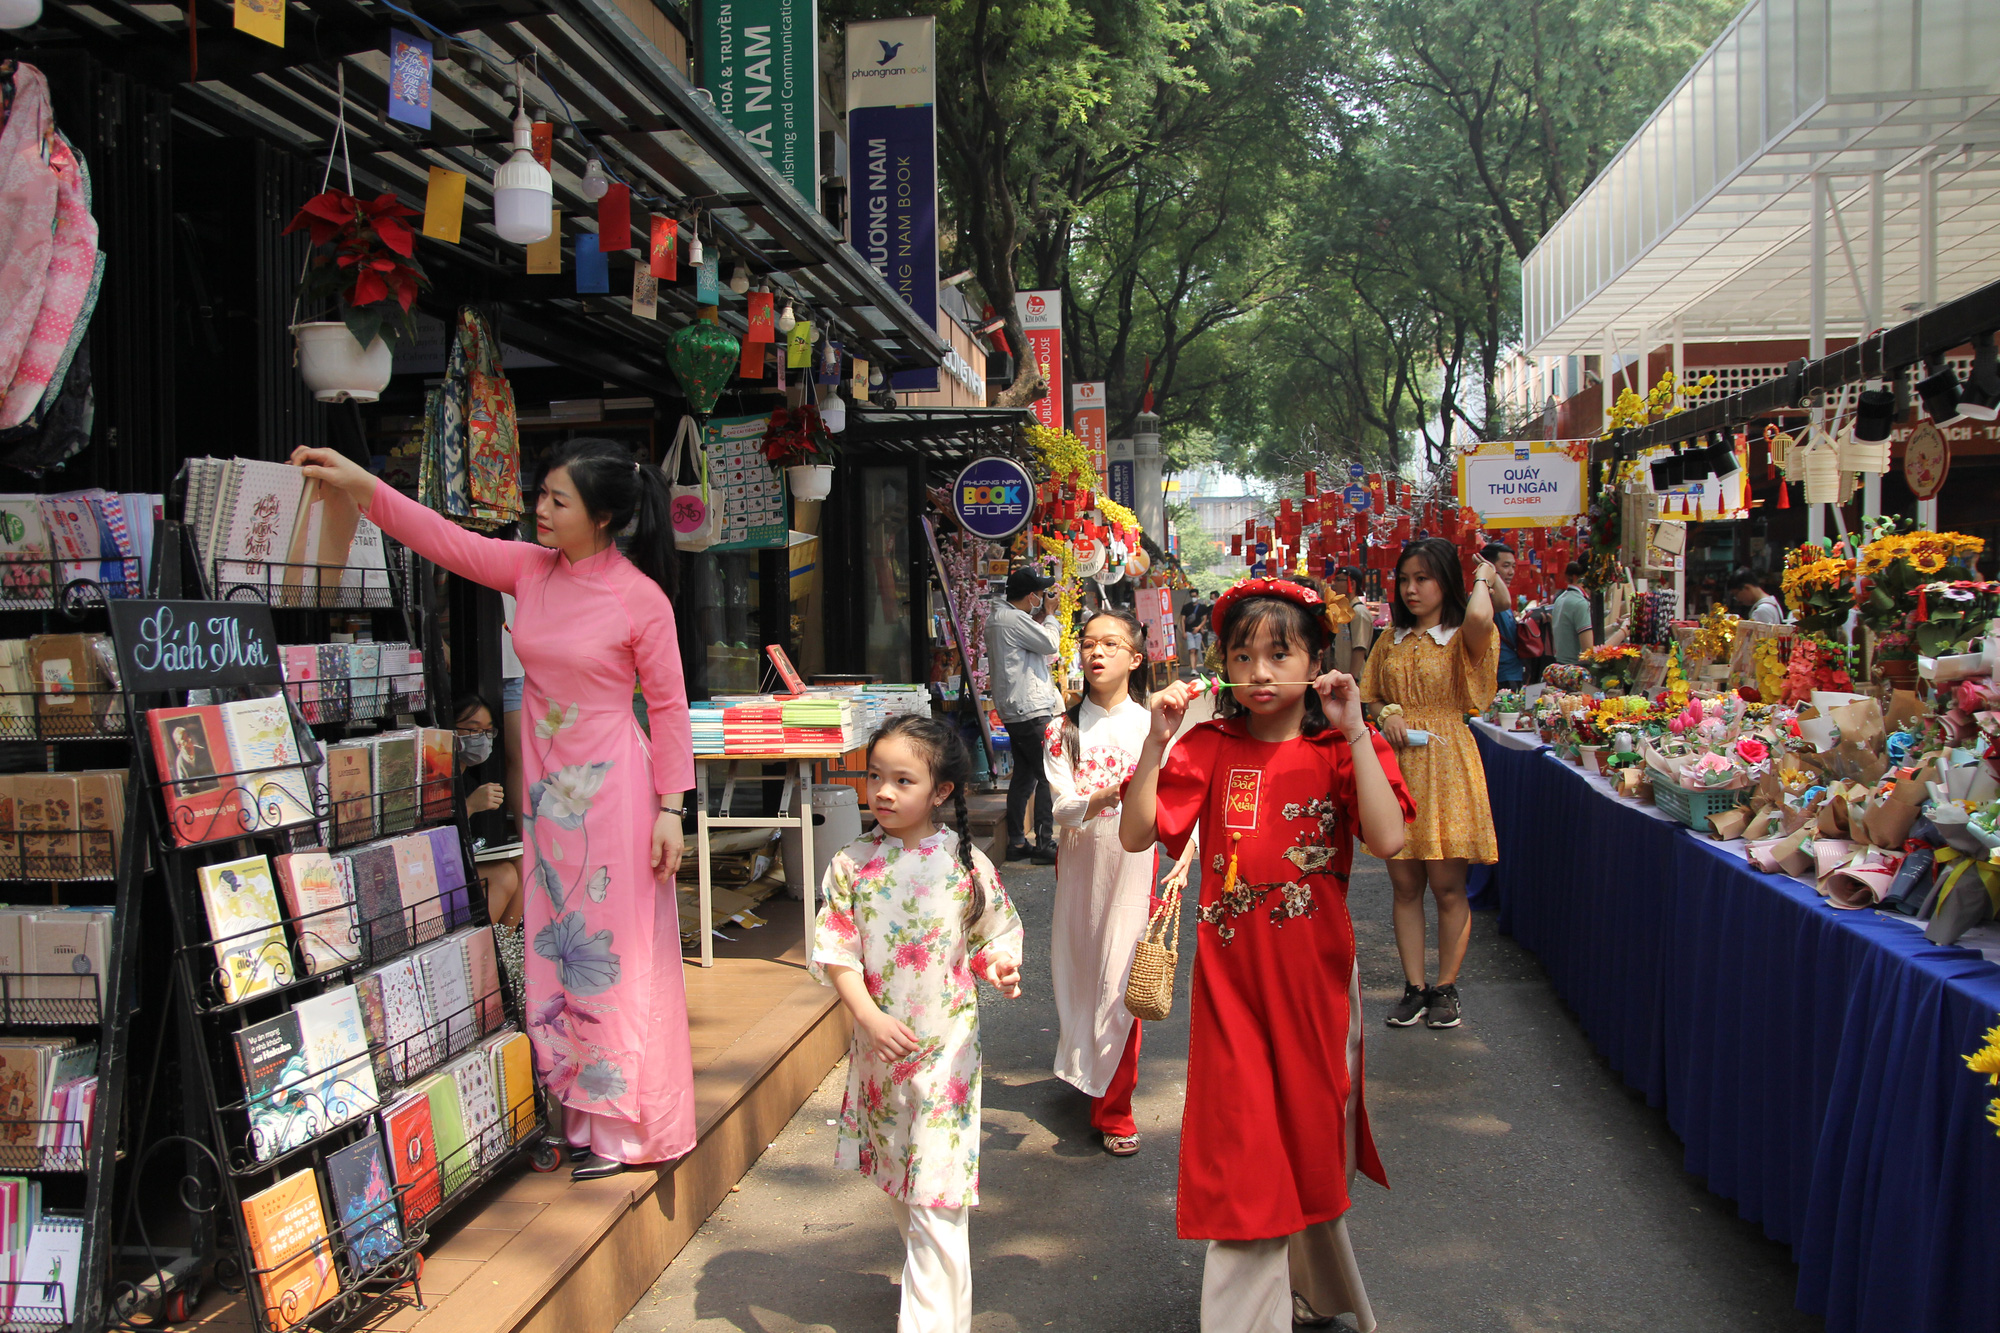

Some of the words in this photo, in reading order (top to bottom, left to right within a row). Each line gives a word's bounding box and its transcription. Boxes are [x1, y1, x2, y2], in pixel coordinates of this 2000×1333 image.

[721, 66, 733, 78] &
[744, 25, 772, 113] NAM
[781, 102, 794, 129] and
[868, 138, 888, 190] NAM
[897, 156, 911, 207] BOOK
[898, 215, 912, 256] NAM
[963, 486, 1021, 505] BOOK
[1488, 483, 1515, 495] THU
[1518, 480, 1558, 494] NGÂN
[963, 504, 1022, 515] STORE
[1503, 496, 1541, 505] CASHIER
[354, 535, 378, 547] START
[134, 606, 208, 672] Sách
[207, 616, 269, 672] Mới
